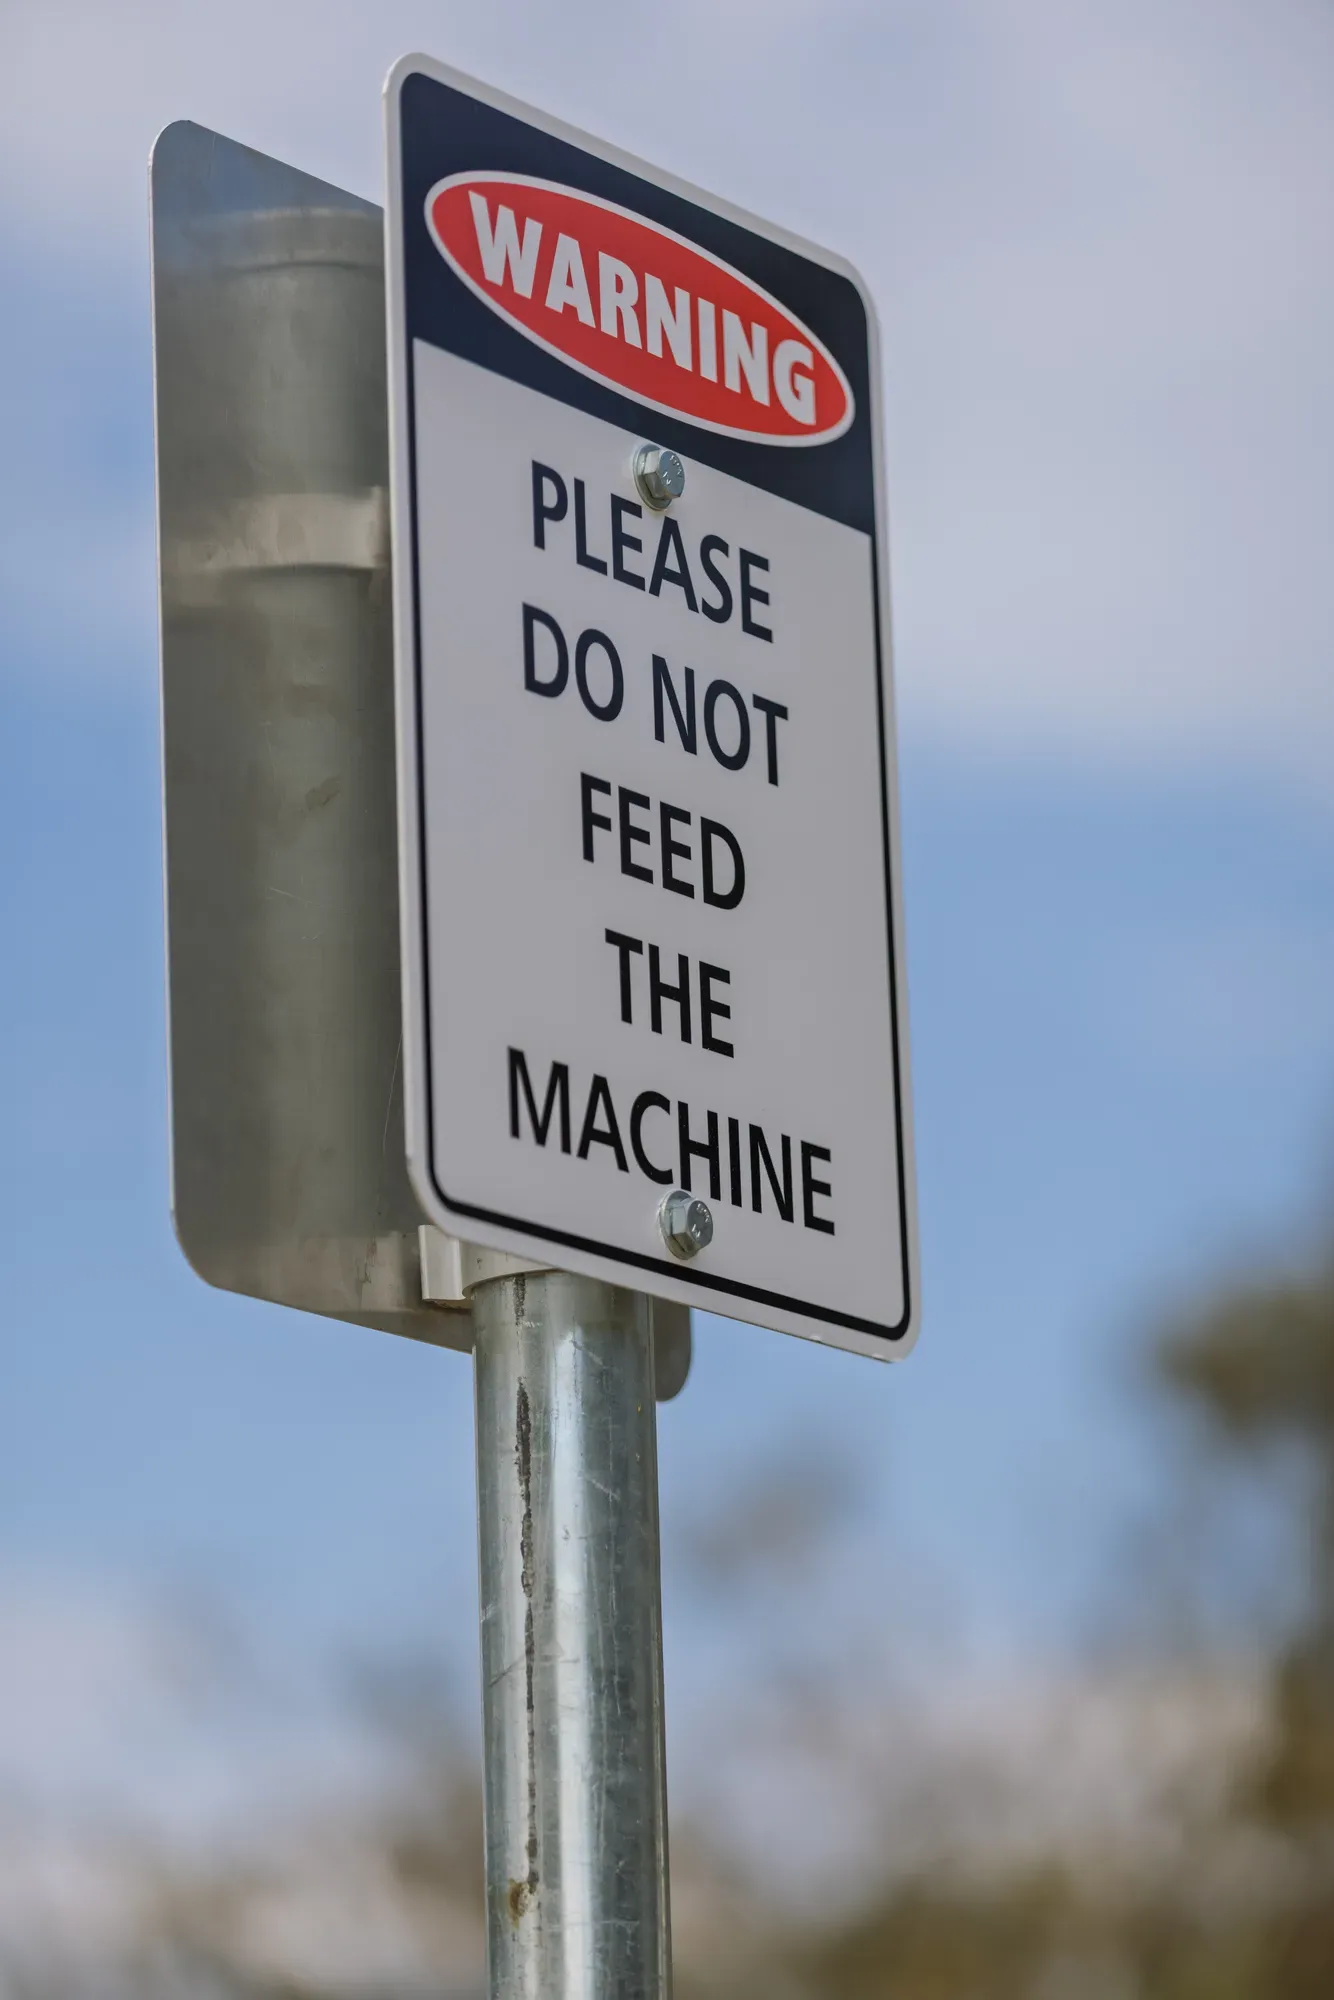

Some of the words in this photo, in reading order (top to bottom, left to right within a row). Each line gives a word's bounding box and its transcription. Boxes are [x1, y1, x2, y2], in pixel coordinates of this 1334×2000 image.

[468, 190, 817, 426] WARNING
[531, 459, 774, 644] PLEASE
[522, 602, 624, 722] DO
[651, 653, 789, 787] NOT
[580, 771, 746, 911] FEED
[604, 927, 735, 1059] THE
[507, 1046, 836, 1237] MACHINE
